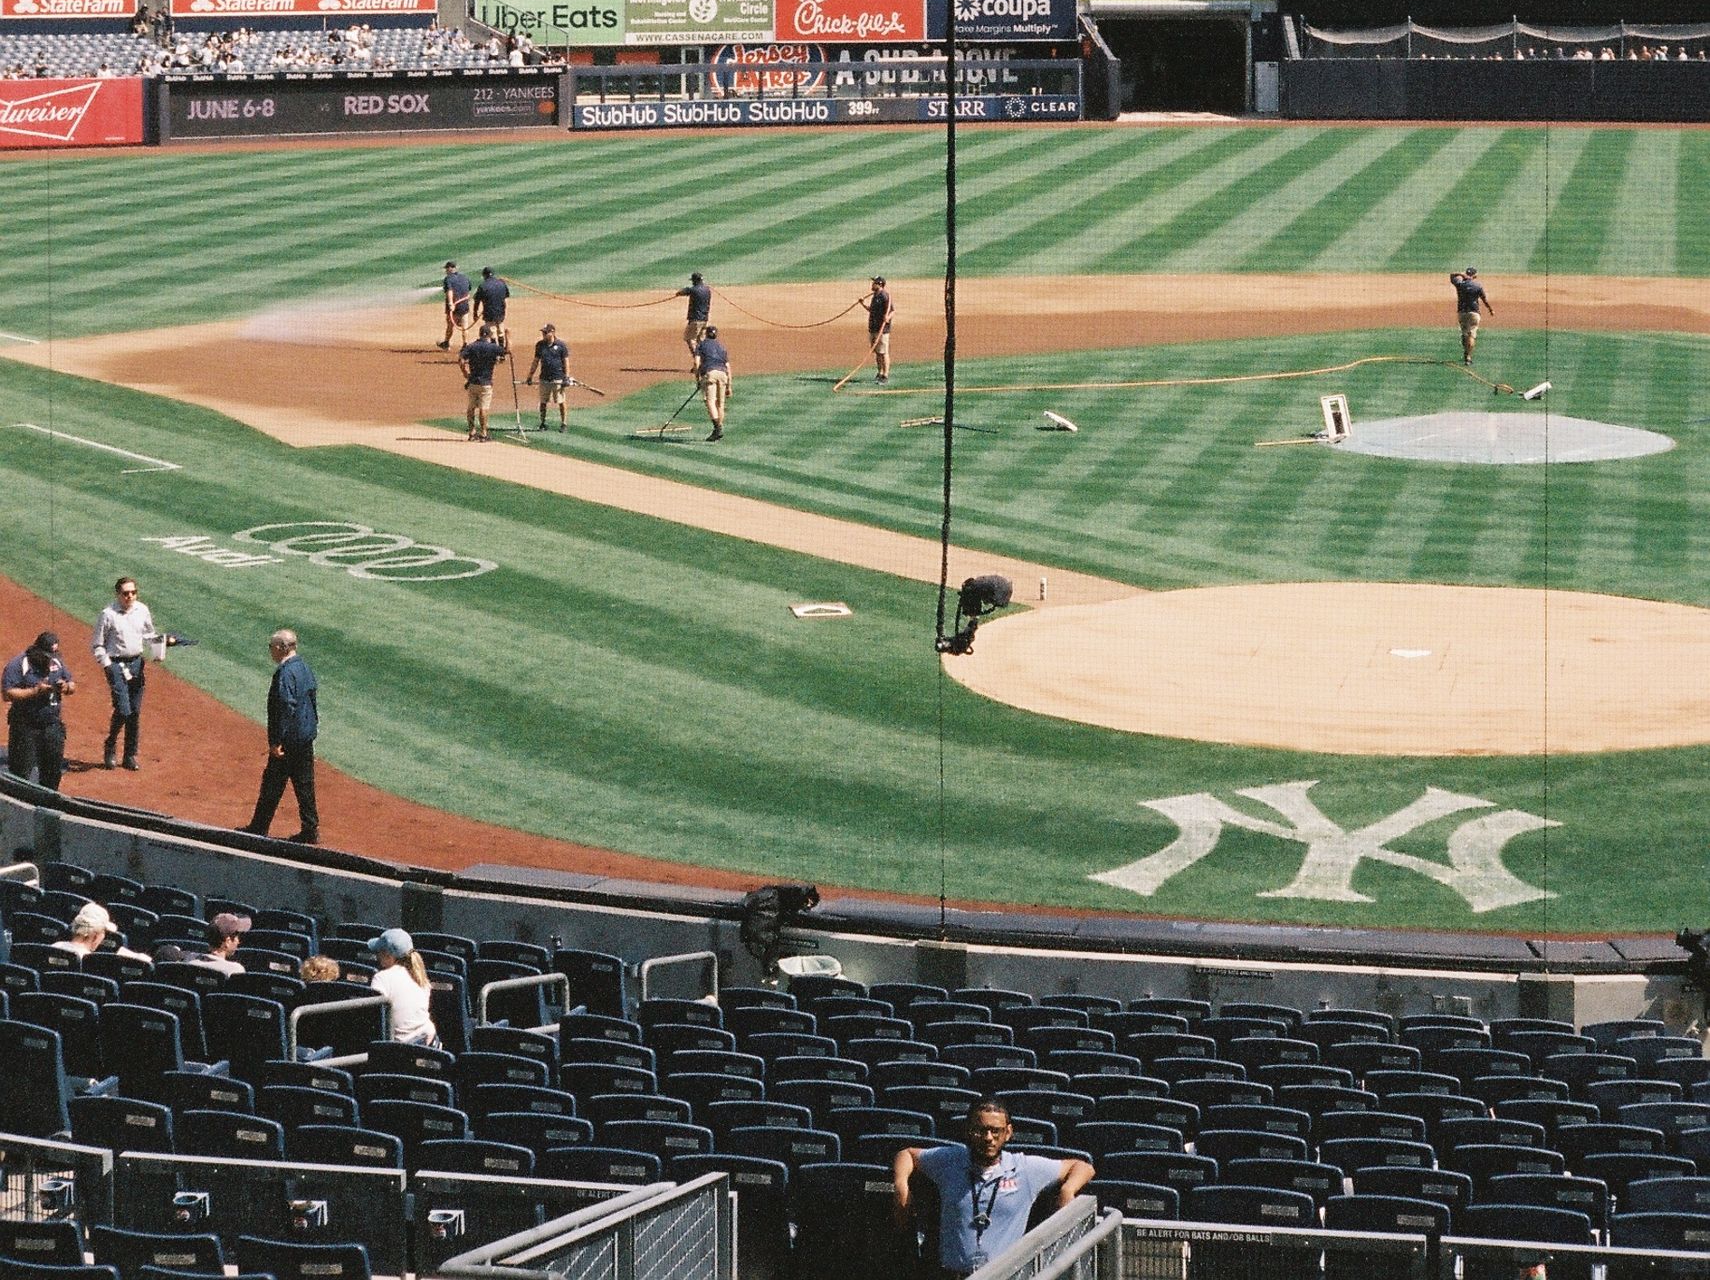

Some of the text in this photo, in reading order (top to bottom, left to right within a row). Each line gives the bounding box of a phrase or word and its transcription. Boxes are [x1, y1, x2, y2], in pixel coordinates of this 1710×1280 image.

[482, 4, 618, 30] Uber Eats
[740, 1, 769, 15] Circle
[636, 32, 764, 42] WWW.CASSENACARE.COM
[975, 24, 1012, 35] Margins
[834, 48, 855, 85] A
[864, 49, 920, 85] SUB
[473, 86, 555, 101] 212 YANKEES
[187, 99, 240, 120] JUNE
[243, 98, 276, 118] 6-8
[344, 95, 385, 116] RED
[387, 94, 431, 115] SOX
[582, 101, 829, 126] StubHub StubHub StubHub
[1031, 102, 1076, 112] CLEAR
[140, 535, 285, 568] Audi
[1086, 780, 1564, 913] NY
[1136, 1228, 1148, 1238] BE
[1148, 1228, 1173, 1239] ALERT
[1174, 1230, 1190, 1240] FOR
[1191, 1230, 1211, 1241] BATS
[1245, 1233, 1270, 1243] BALLS
